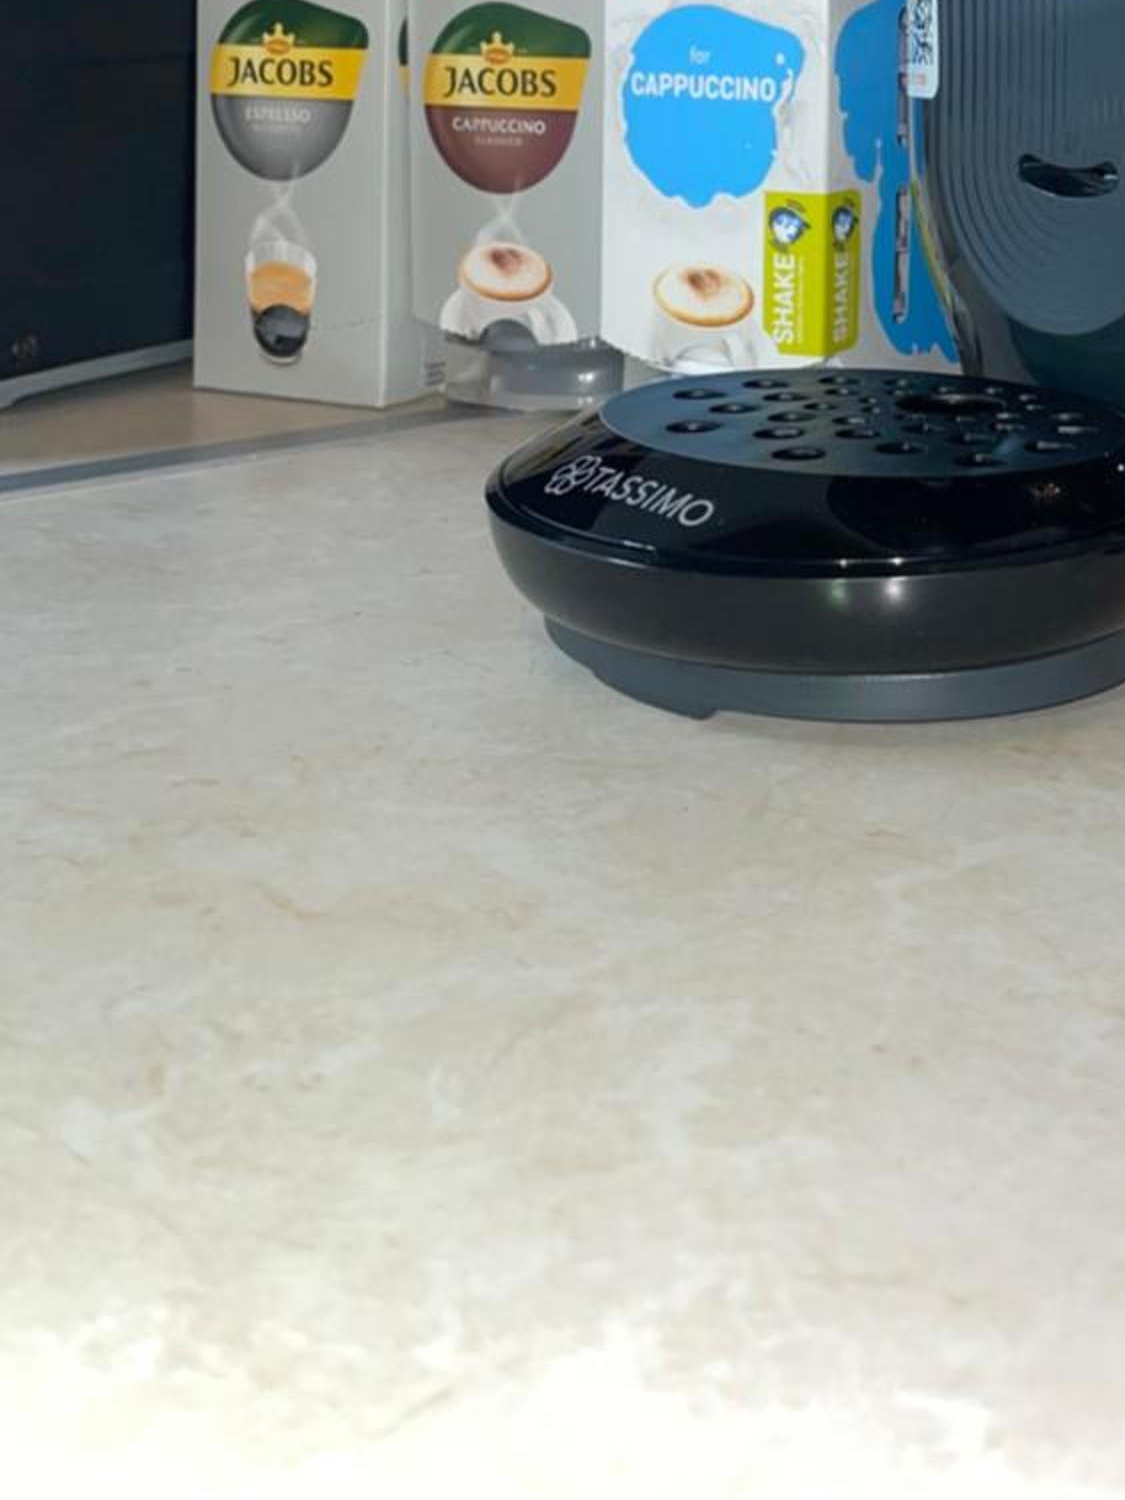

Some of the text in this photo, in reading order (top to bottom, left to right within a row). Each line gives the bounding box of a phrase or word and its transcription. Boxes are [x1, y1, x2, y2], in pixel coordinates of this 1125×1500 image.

[689, 44, 711, 65] for
[227, 56, 334, 87] JACOBS
[443, 66, 556, 98] JACOBS
[630, 71, 777, 102] CAPPUCCINO
[452, 116, 546, 134] CAPPUCCINO
[773, 253, 795, 344] SHAKE
[833, 252, 849, 343] SHAKE
[584, 466, 714, 527] TASSIMO
